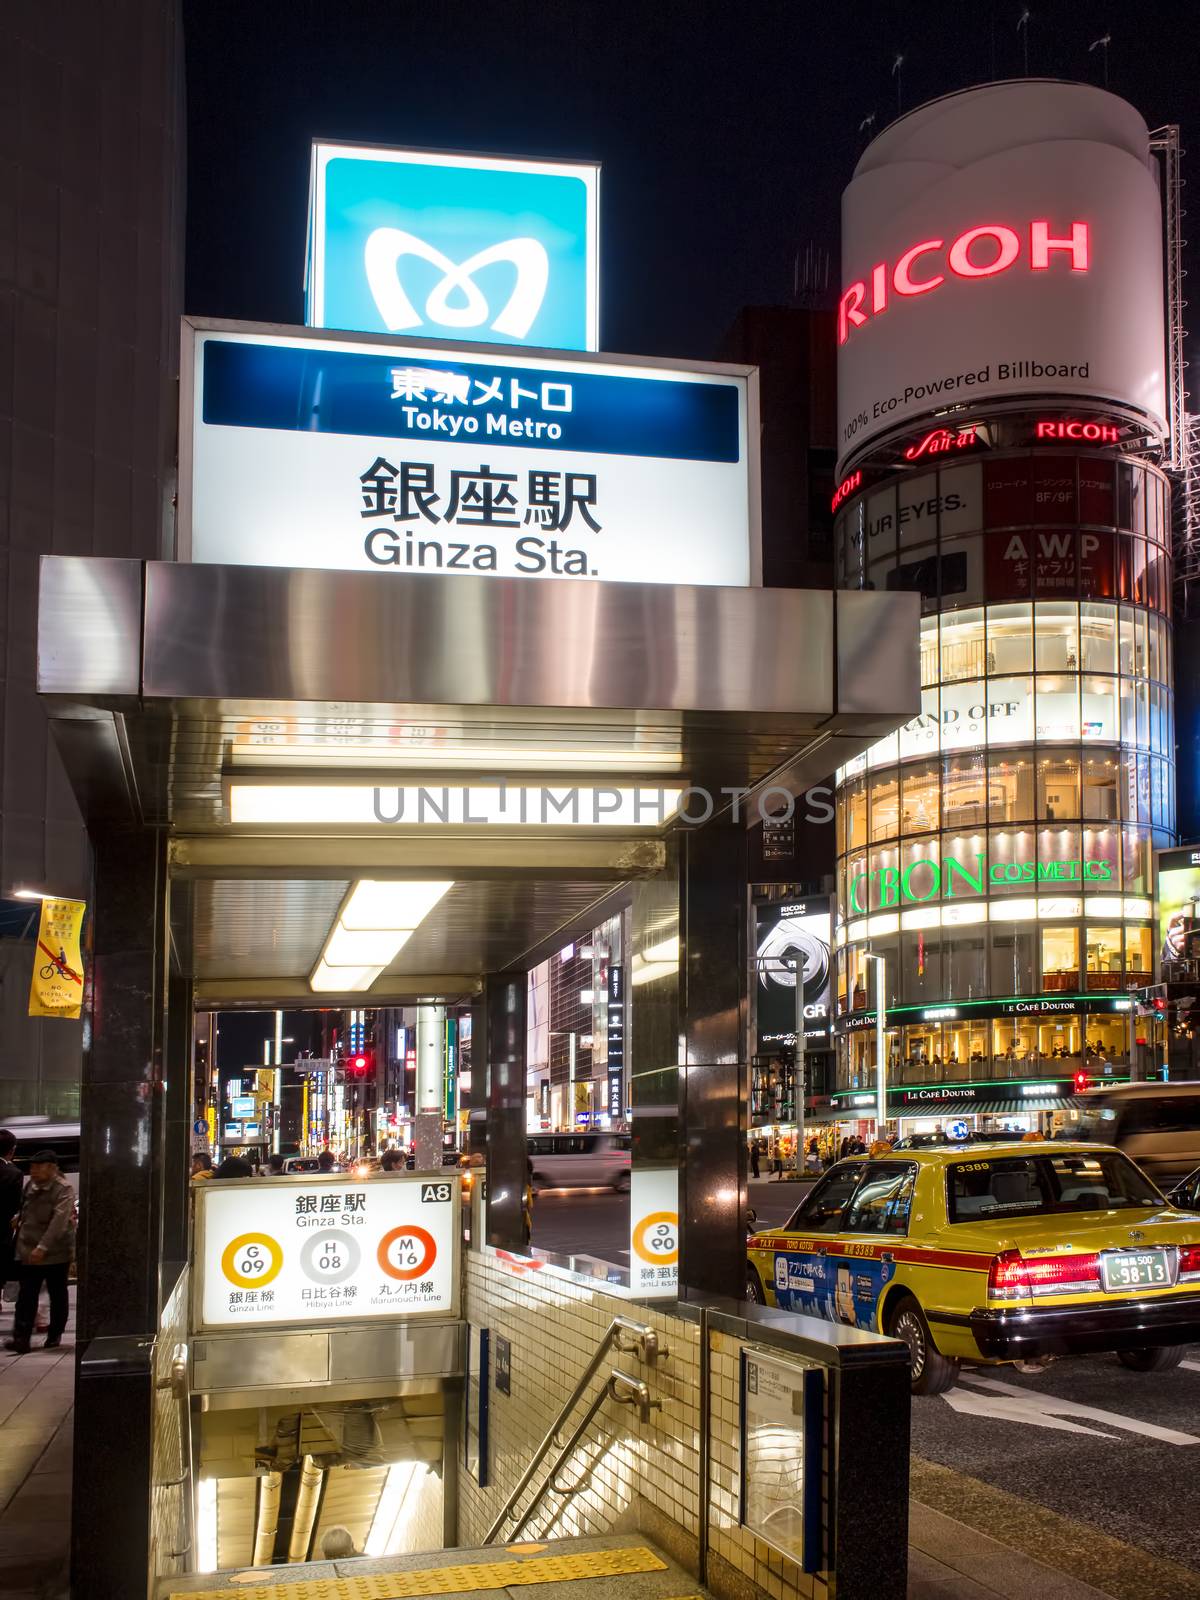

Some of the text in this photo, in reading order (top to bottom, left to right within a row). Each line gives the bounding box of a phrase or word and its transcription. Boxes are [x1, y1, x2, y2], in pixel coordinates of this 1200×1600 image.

[838, 221, 1089, 345] RICOH
[390, 369, 573, 413] 東京メトロ
[843, 361, 1090, 442] 100% Eco-Powered Billboard
[402, 406, 562, 440] Tokyo Metro
[1037, 422, 1119, 442] RICOH
[359, 456, 603, 534] 銀座駅
[1036, 491, 1073, 503] 8F/9F
[897, 494, 967, 524] EYES.
[364, 527, 599, 576] Ginza Sta.
[967, 701, 1021, 720] OFF
[990, 860, 1113, 883] COSMETICS
[780, 904, 807, 913] RICOH
[803, 1004, 827, 1019] GR
[956, 1162, 990, 1173] 3389
[422, 1185, 450, 1202] A8
[295, 1193, 367, 1214] 銀座駅
[296, 1213, 367, 1228] Ginza Sta.
[325, 1242, 337, 1255] H
[399, 1239, 414, 1250] M
[760, 1238, 775, 1248] TAXI
[855, 1245, 875, 1256] 3389
[246, 1246, 260, 1259] G
[397, 1252, 418, 1266] 16
[1137, 1255, 1153, 1265] 500
[241, 1259, 265, 1274] 09
[319, 1256, 342, 1270] 08
[1120, 1264, 1165, 1284] 98-13
[301, 1284, 358, 1301] 日比谷線
[378, 1281, 435, 1297] 丸ノ内線
[229, 1289, 276, 1305] 銀座線
[306, 1298, 353, 1309] Hibiya Line
[370, 1294, 442, 1305] Marunouchi Line
[228, 1302, 275, 1313] Ginza Line
